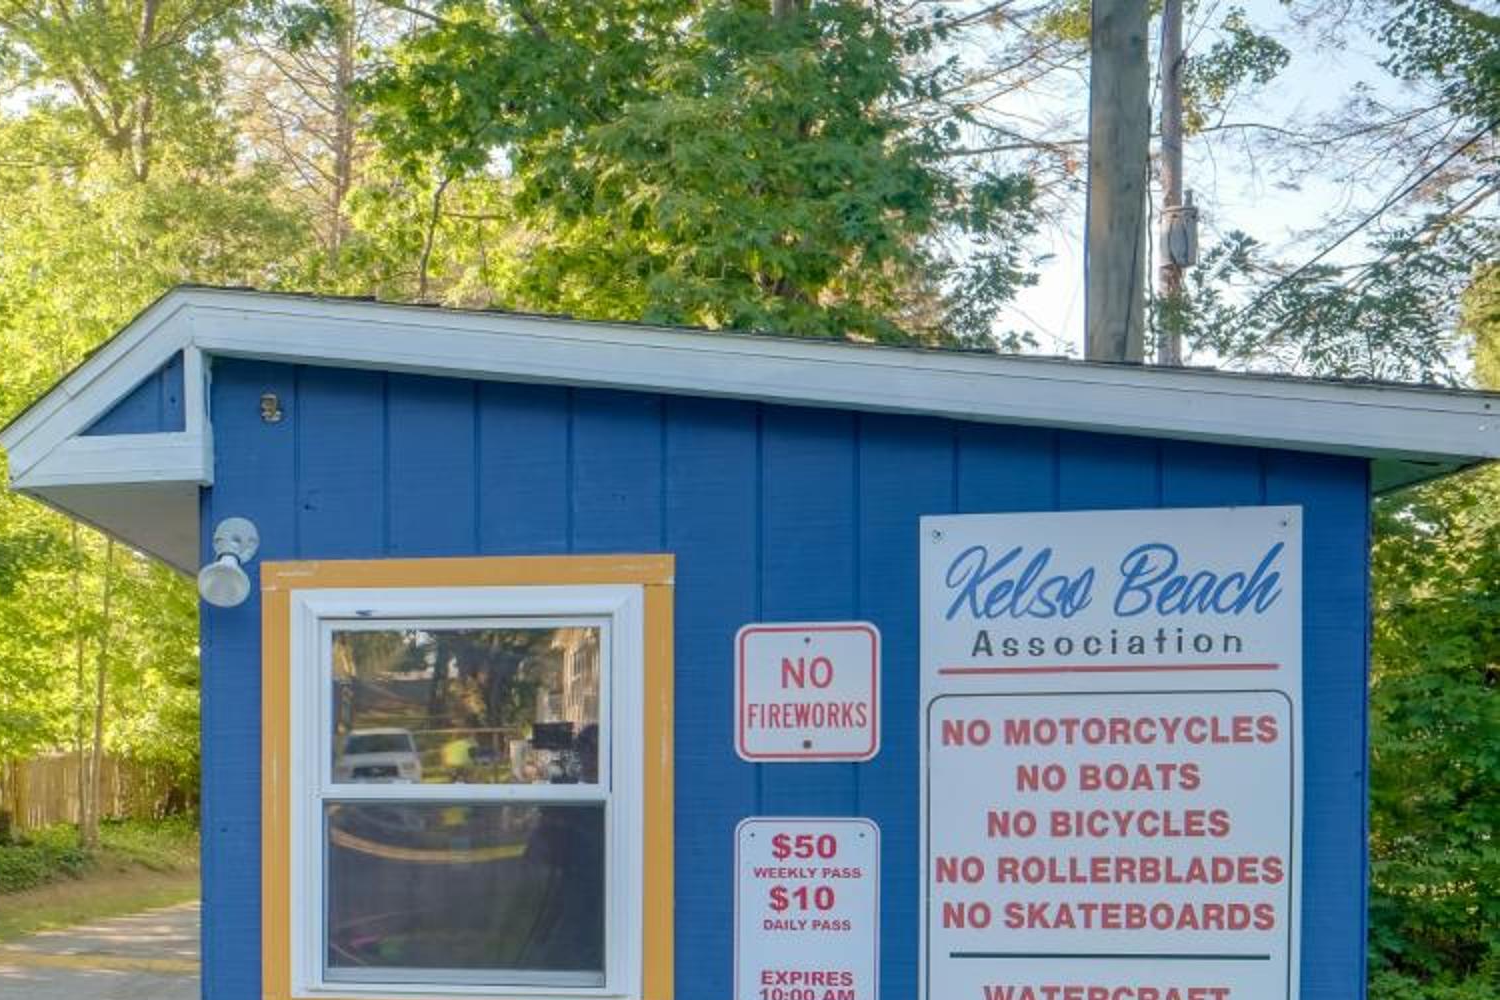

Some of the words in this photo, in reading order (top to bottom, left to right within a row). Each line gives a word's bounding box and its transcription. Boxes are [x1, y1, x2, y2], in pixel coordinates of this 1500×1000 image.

[946, 545, 1094, 620] Kelso
[1114, 542, 1285, 617] Beach
[971, 627, 1243, 656] Association
[782, 656, 834, 689] NO
[747, 701, 868, 729] FIREWORKS
[942, 719, 991, 746] NO
[1004, 716, 1279, 745] MOTORCYCLES
[1016, 765, 1067, 791] NO
[1079, 763, 1201, 791] BOATS
[987, 811, 1037, 838] NO
[1050, 809, 1231, 838] BICYCLES
[771, 832, 838, 861] $50
[753, 867, 818, 879] WEEKLY
[822, 867, 863, 878] PASS
[935, 857, 985, 884] NO
[998, 856, 1285, 884] ROLLERBLADES
[768, 884, 835, 913] $10
[763, 919, 807, 931] DAILY
[811, 919, 852, 931] PASS
[942, 902, 991, 929] NO
[1004, 902, 1276, 931] SKATEBOARDS
[760, 970, 853, 987] EXPIRES
